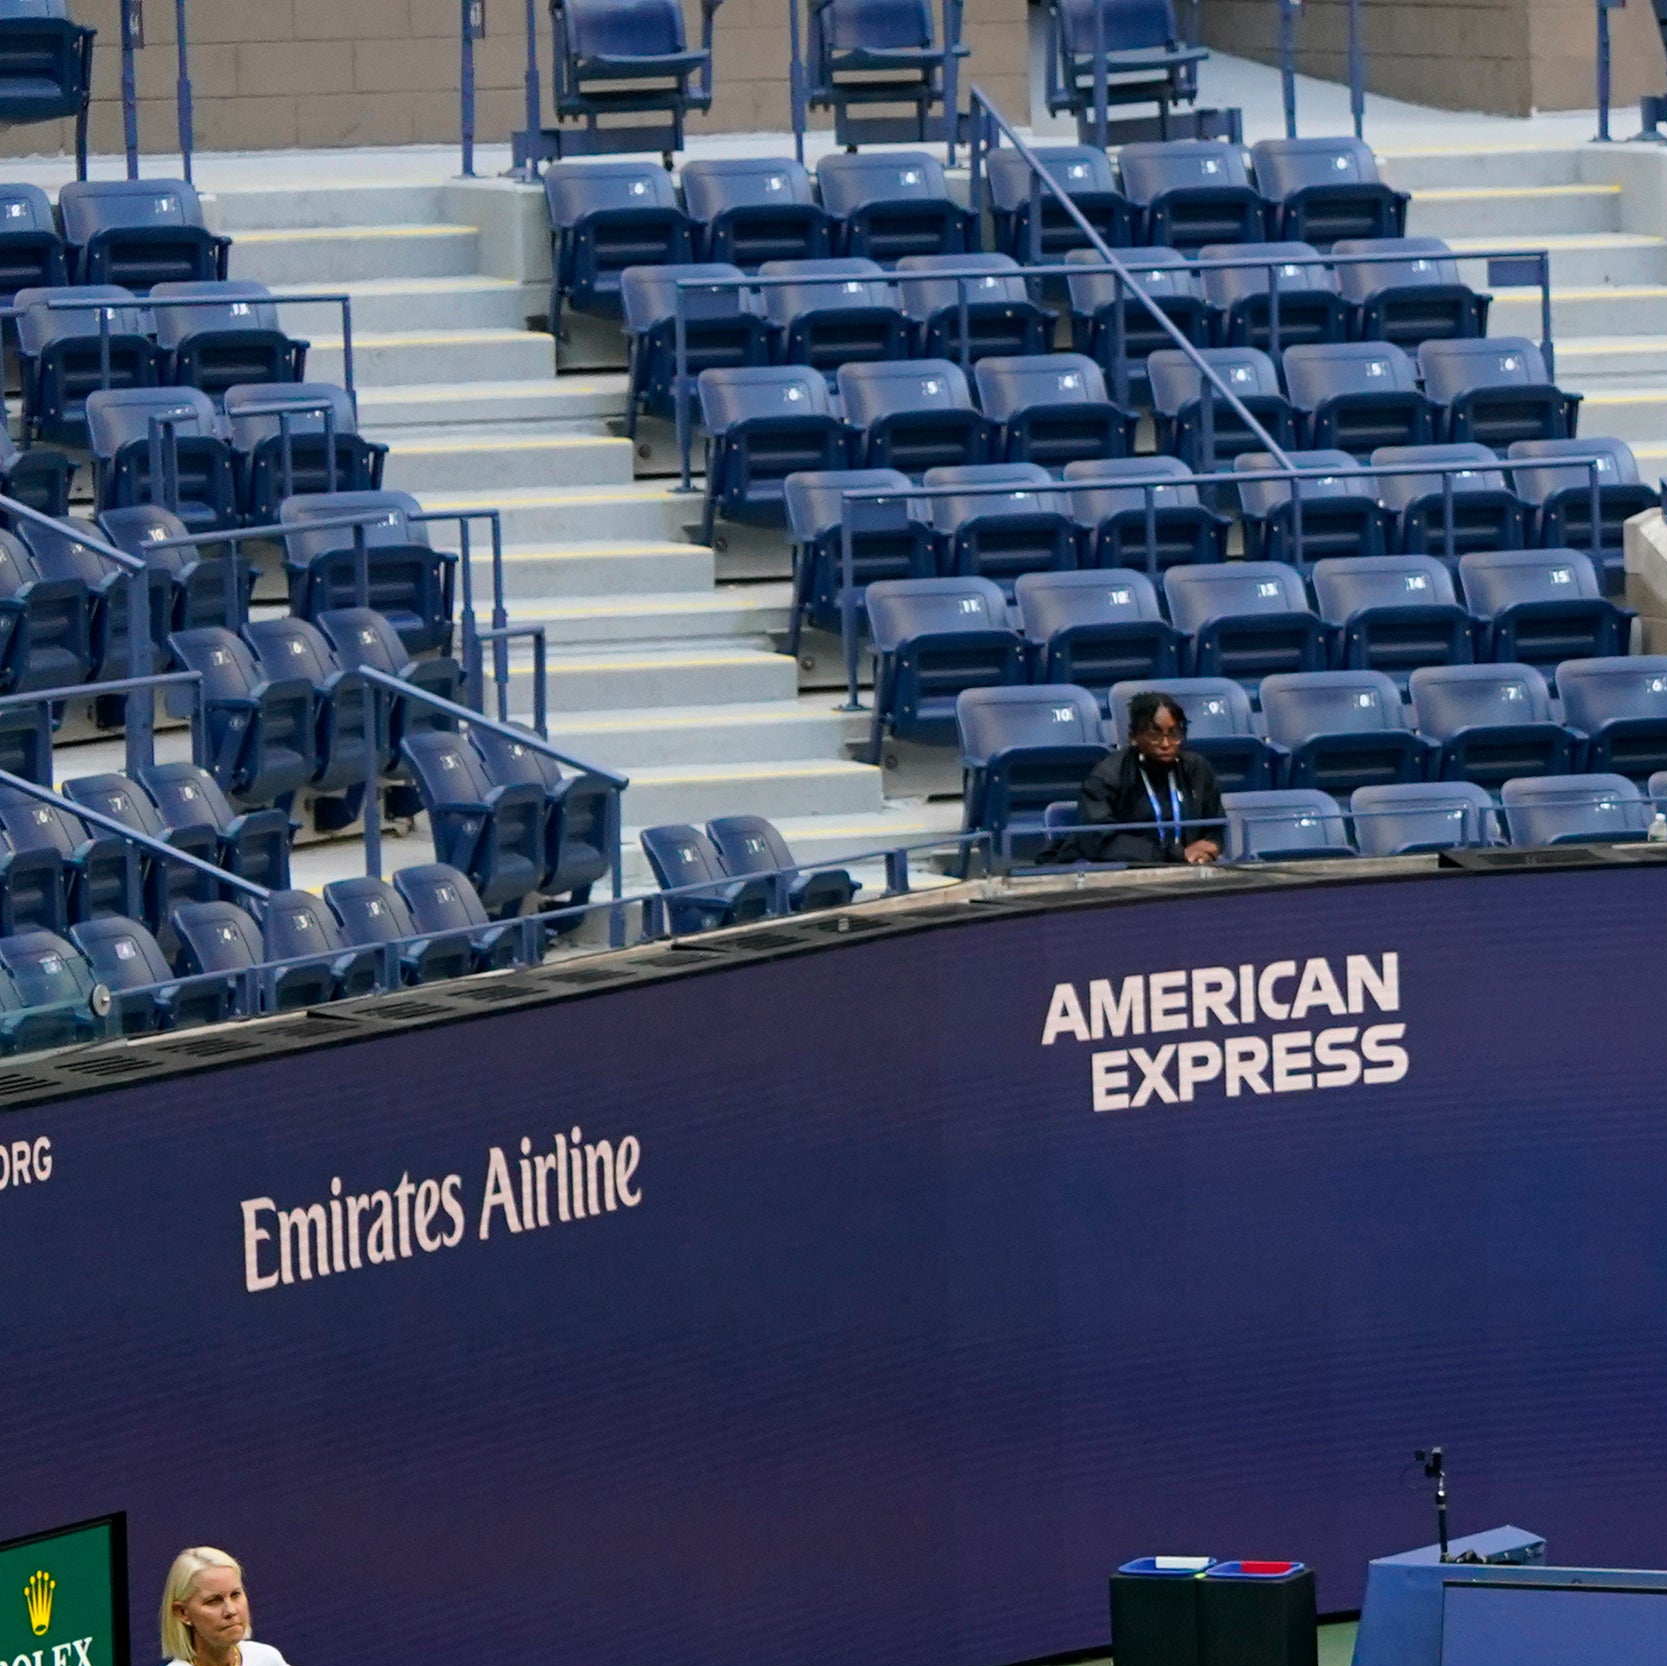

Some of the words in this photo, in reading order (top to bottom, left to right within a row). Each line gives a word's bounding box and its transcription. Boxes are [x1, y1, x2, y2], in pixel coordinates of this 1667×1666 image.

[1041, 952, 1399, 1045] AMERICAN
[1092, 1023, 1409, 1112] EXPRESS
[242, 1173, 463, 1291] Emirates
[480, 1127, 640, 1239] Airline
